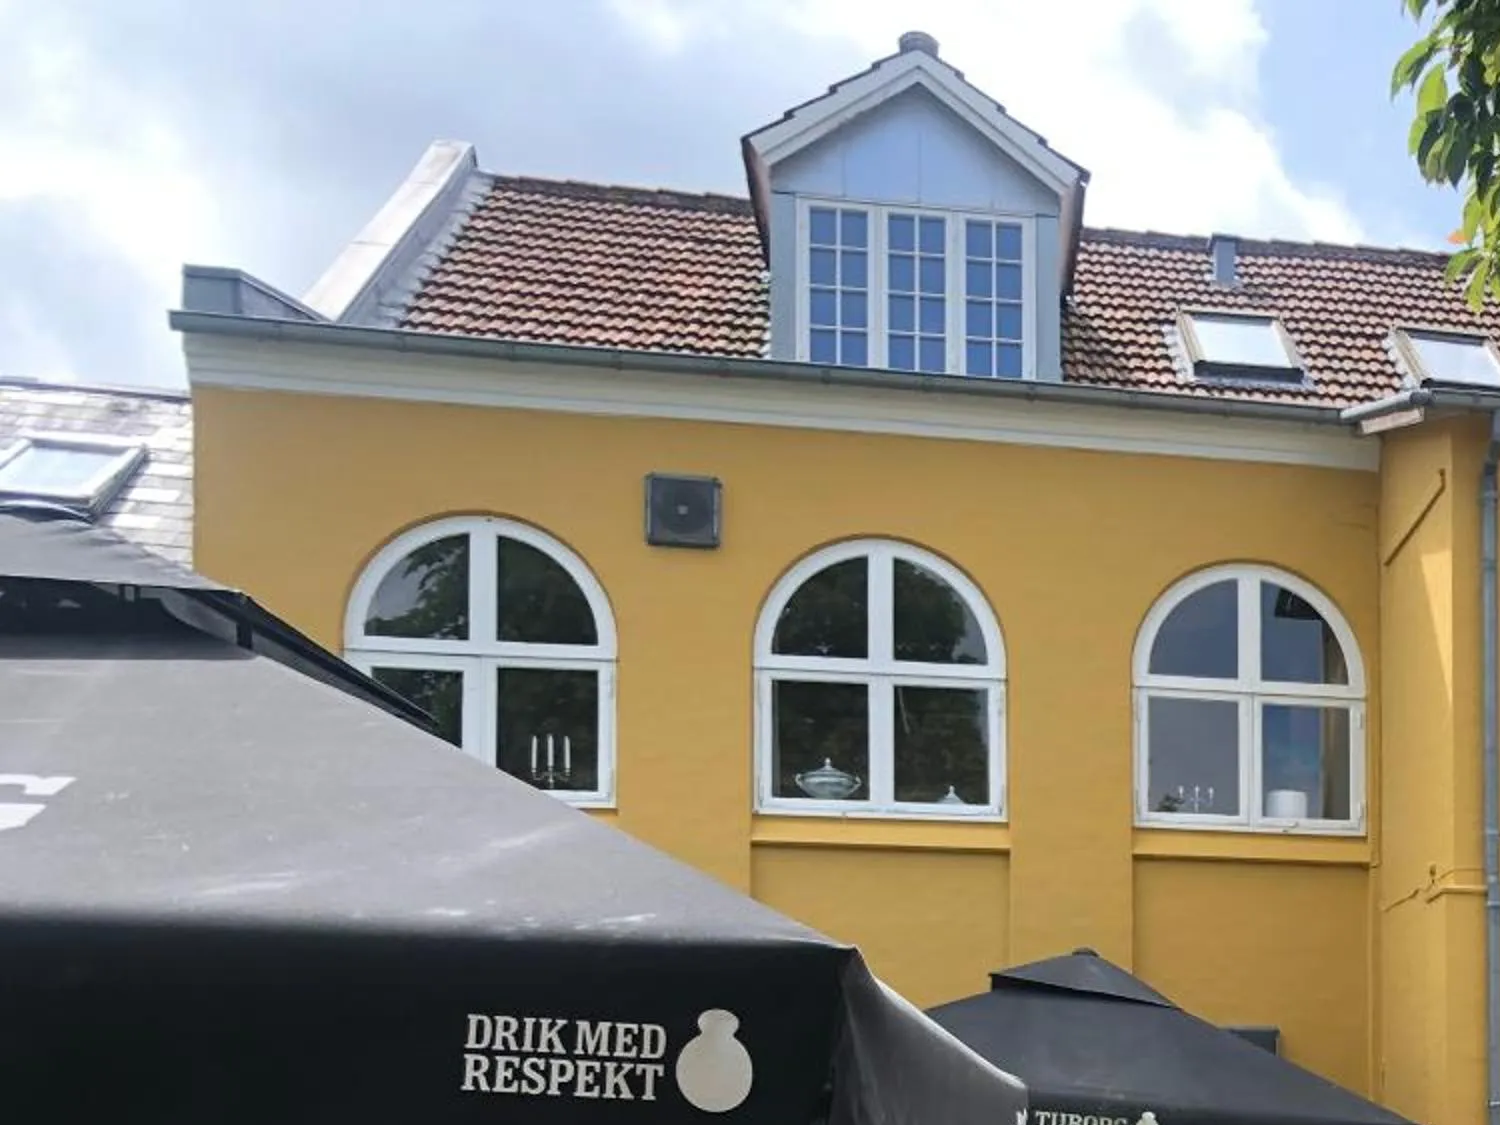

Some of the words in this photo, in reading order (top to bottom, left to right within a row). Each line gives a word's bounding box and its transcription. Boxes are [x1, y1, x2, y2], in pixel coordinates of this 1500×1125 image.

[464, 1013, 566, 1054] DRIK
[574, 1019, 667, 1059] MED
[460, 1053, 665, 1100] RESPEKT
